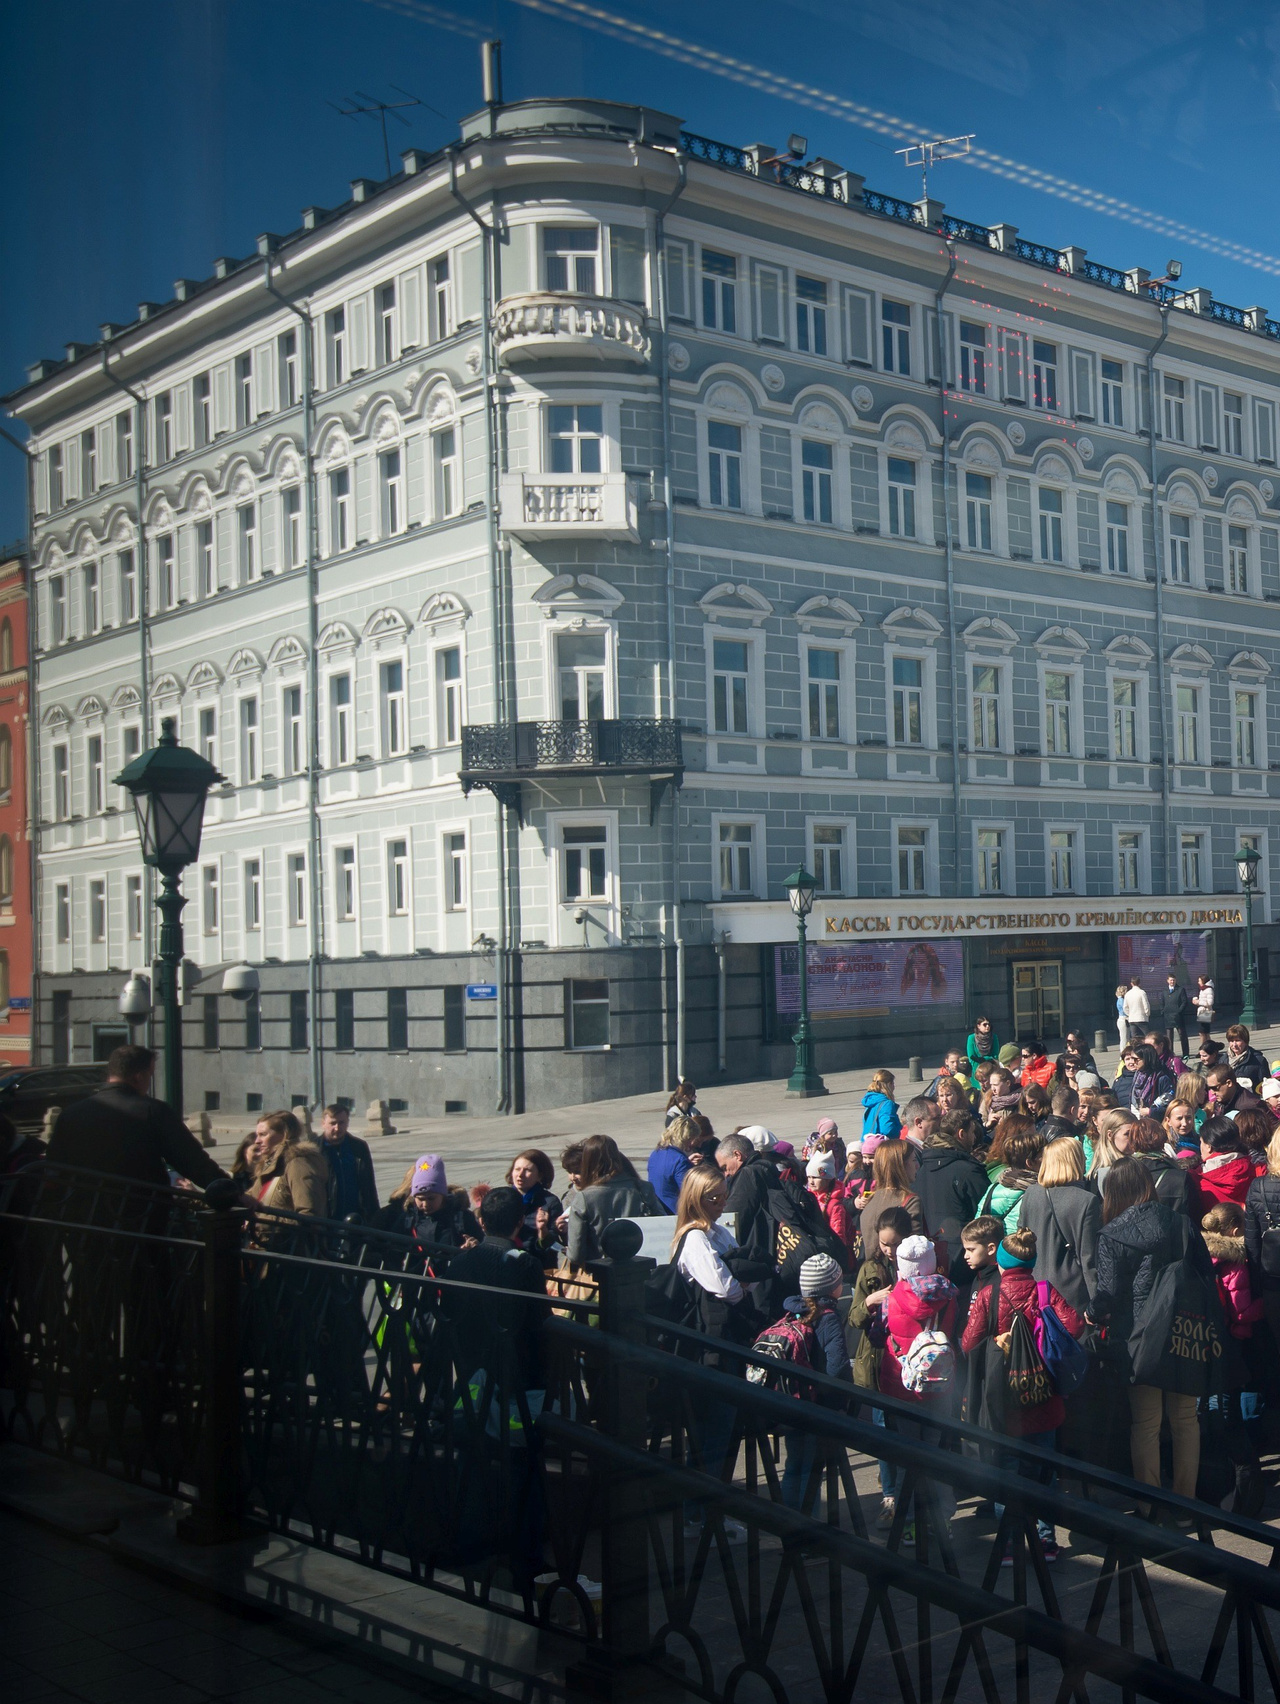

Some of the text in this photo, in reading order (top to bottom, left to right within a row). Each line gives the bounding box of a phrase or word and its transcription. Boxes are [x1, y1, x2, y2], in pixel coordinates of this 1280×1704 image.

[825, 916, 892, 933] КАССЫ
[897, 912, 1071, 933] ГОСУДАРСТВЕННОГО
[1189, 909, 1244, 926] ДВОРЦА
